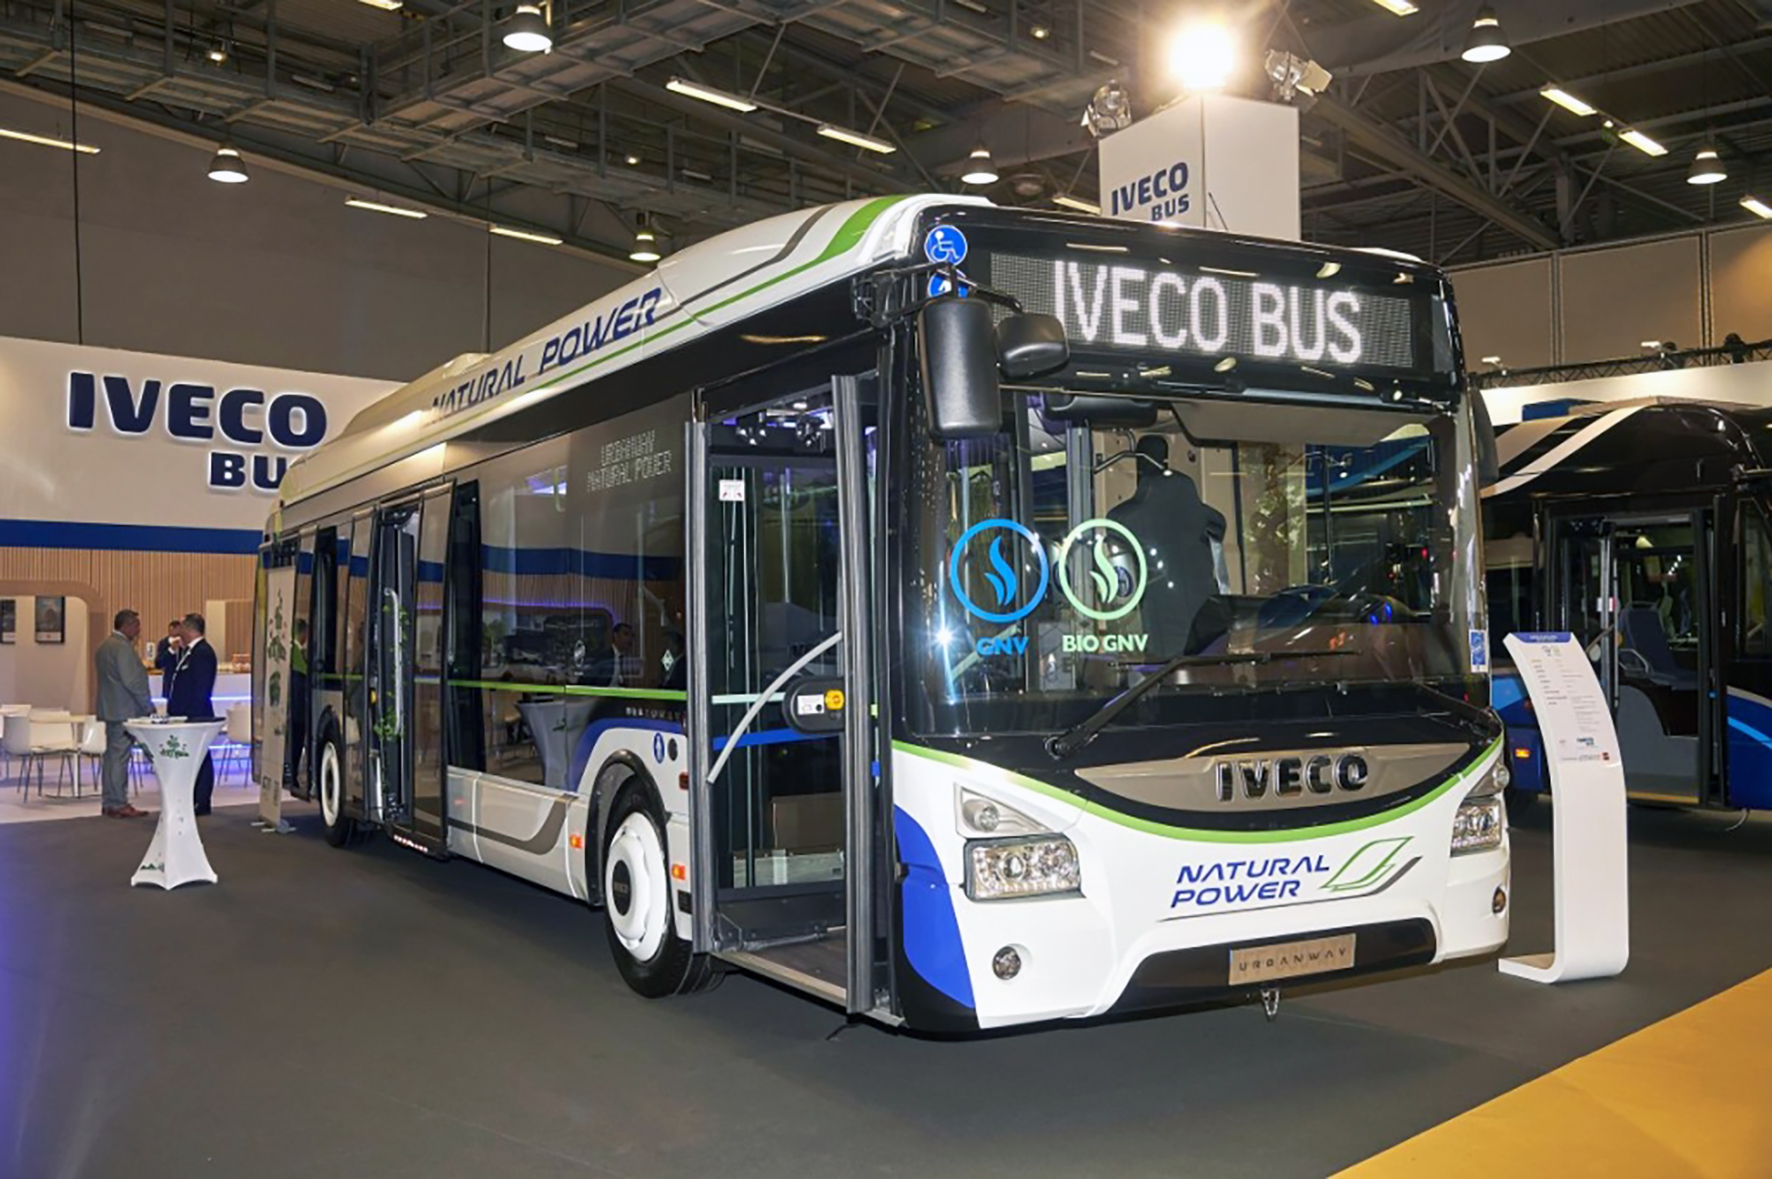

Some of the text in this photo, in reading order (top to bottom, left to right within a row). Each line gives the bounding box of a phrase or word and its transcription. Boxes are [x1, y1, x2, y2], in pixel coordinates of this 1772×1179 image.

[1111, 161, 1189, 216] IVECO
[1151, 193, 1190, 222] BUS
[1054, 259, 1363, 364] IVECO BUS
[432, 287, 662, 416] NATURAL POWER
[69, 371, 328, 447] IVECO
[210, 451, 288, 488] BU
[976, 636, 1029, 656] GNV
[1062, 633, 1148, 652] BIO GNV
[1215, 754, 1369, 802] IVECO
[1176, 854, 1330, 884] NATURAL
[1170, 879, 1301, 908] POWER
[1238, 947, 1347, 972] URBANWAY
